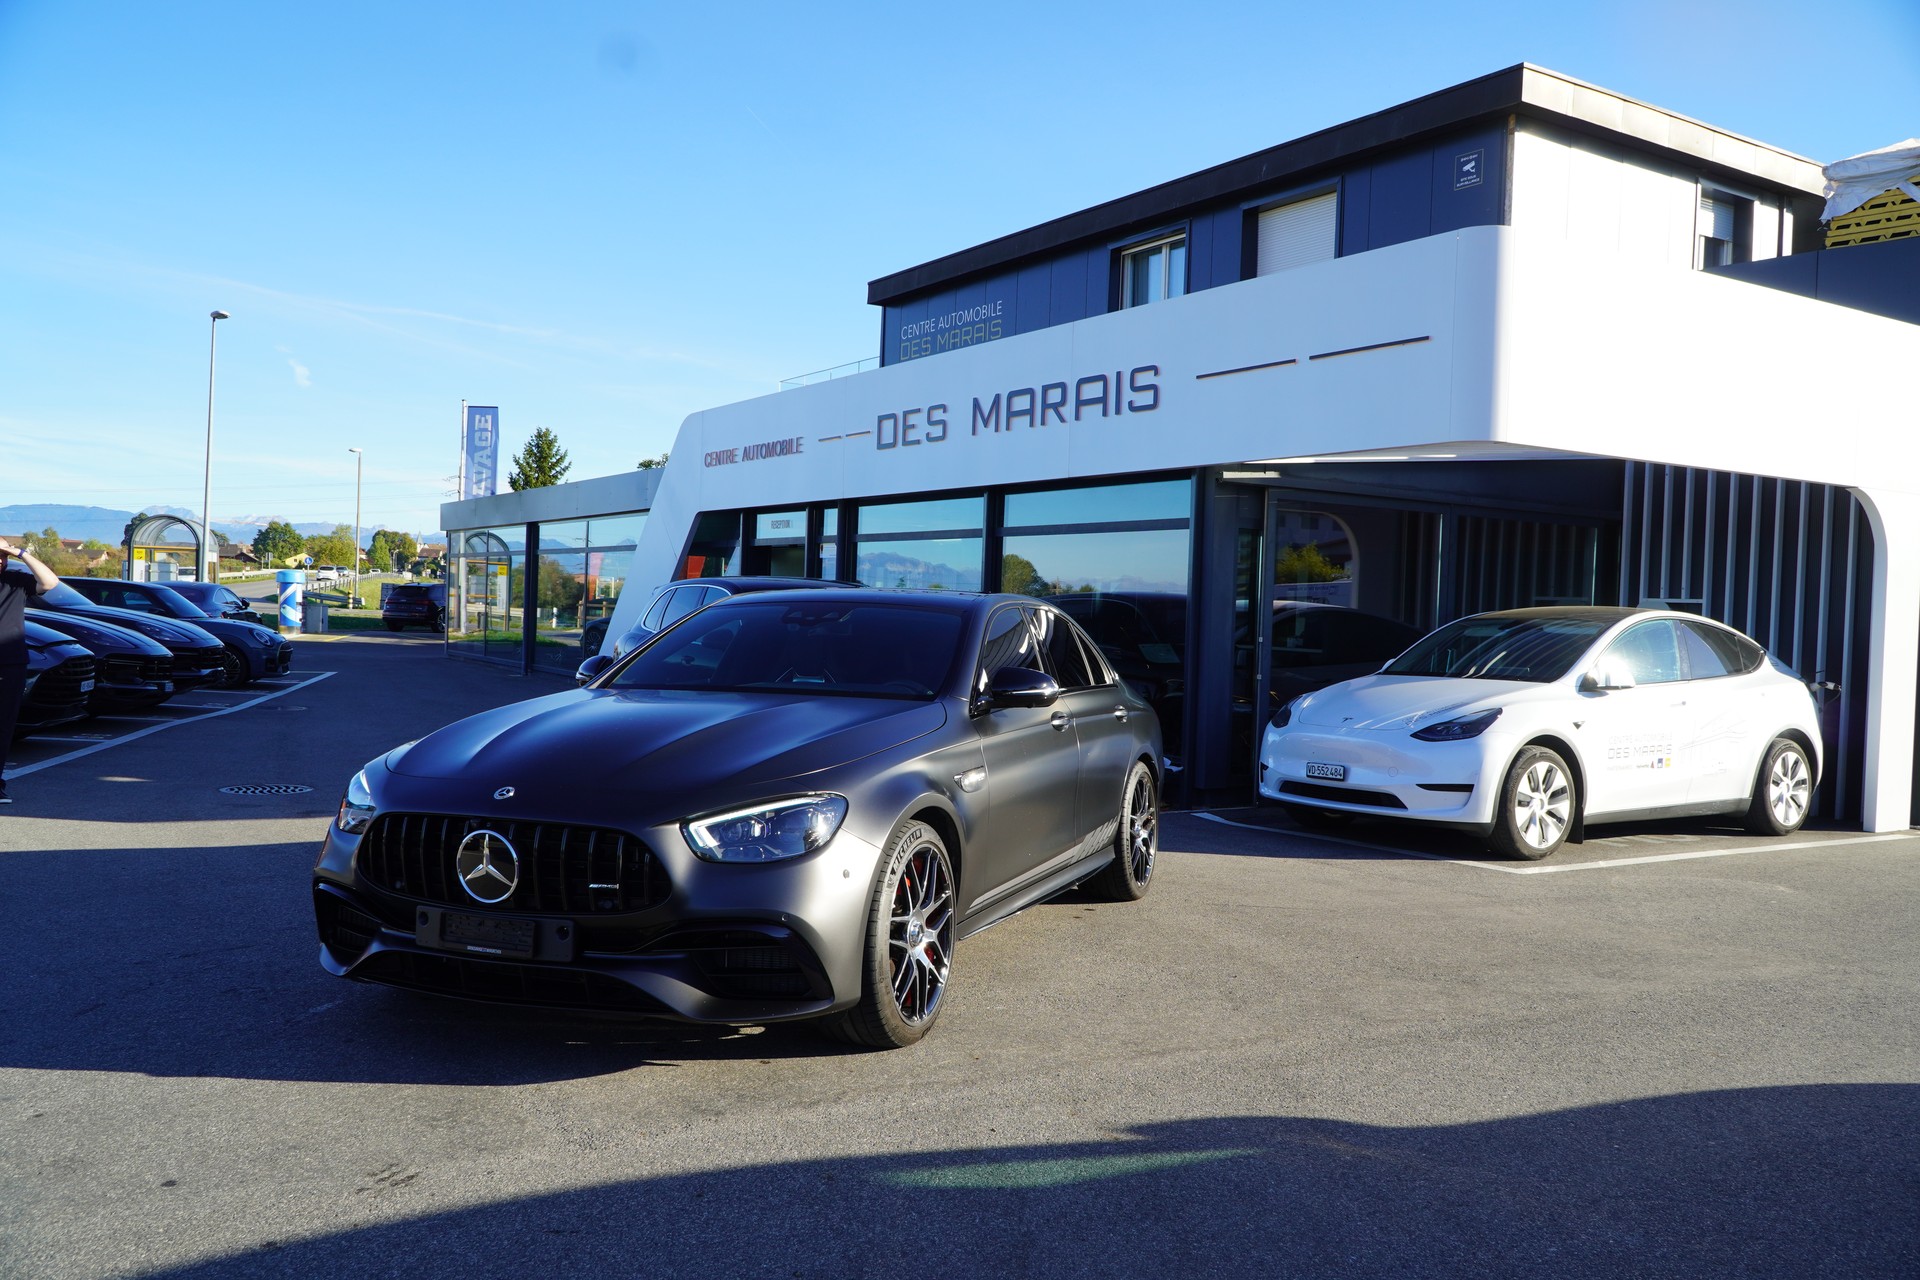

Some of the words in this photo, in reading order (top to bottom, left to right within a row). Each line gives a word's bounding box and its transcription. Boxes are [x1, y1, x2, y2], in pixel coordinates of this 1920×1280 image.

[900, 336, 932, 361] DES
[936, 319, 1002, 352] MARAIS
[901, 318, 936, 340] CENTRE
[938, 300, 1003, 330] AUTOMOBILE
[876, 403, 948, 450] DES
[971, 364, 1160, 436] MARAIS
[704, 447, 739, 468] CENTRE
[742, 436, 804, 462] AUTOMOBILE
[1607, 747, 1630, 760] DES
[1633, 743, 1673, 757] MARAIS
